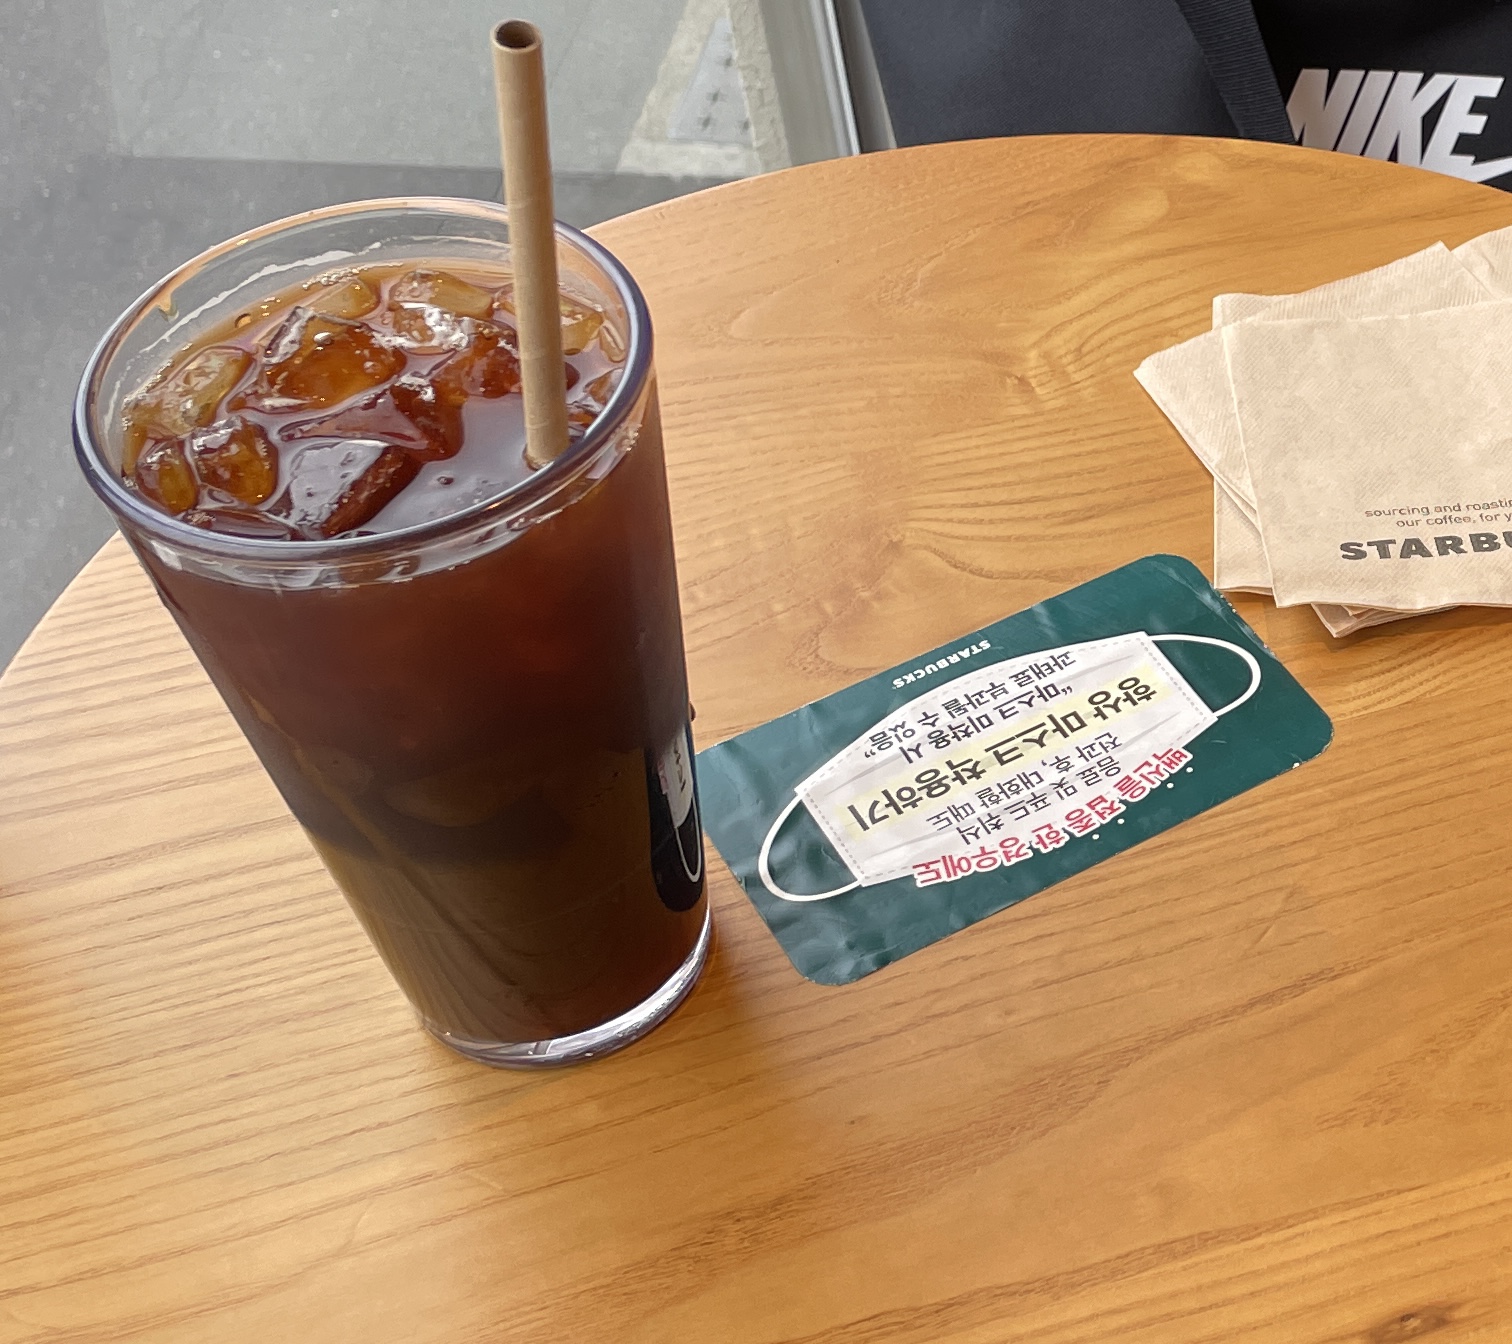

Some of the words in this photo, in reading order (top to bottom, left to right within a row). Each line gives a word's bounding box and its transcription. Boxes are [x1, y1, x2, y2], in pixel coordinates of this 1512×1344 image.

[1286, 68, 1505, 167] NIKE
[1364, 505, 1430, 517] sourcing
[1433, 502, 1462, 513] and
[1396, 518, 1422, 528] our
[1479, 512, 1501, 523] for
[1009, 651, 1076, 688] 과태료
[942, 682, 1009, 719] 부과될
[1088, 677, 1157, 721] 항상
[917, 712, 939, 727] 수
[927, 713, 994, 749] 미착용
[898, 743, 923, 764] 시
[984, 710, 1088, 766] 마스크
[1075, 732, 1122, 762] 전과
[1041, 755, 1075, 774] 후,
[1076, 755, 1121, 786] 음료
[1113, 748, 1188, 799] 백신을
[846, 758, 987, 832] 착용하기
[975, 771, 1044, 808] 대화할
[1049, 777, 1078, 800] 및
[926, 803, 975, 831] 때도
[1004, 792, 1051, 821] 푸드
[1065, 795, 1121, 833] 접종
[956, 813, 1004, 845] 취식
[1031, 823, 1065, 849] 한
[912, 837, 1028, 884] 경우에도
